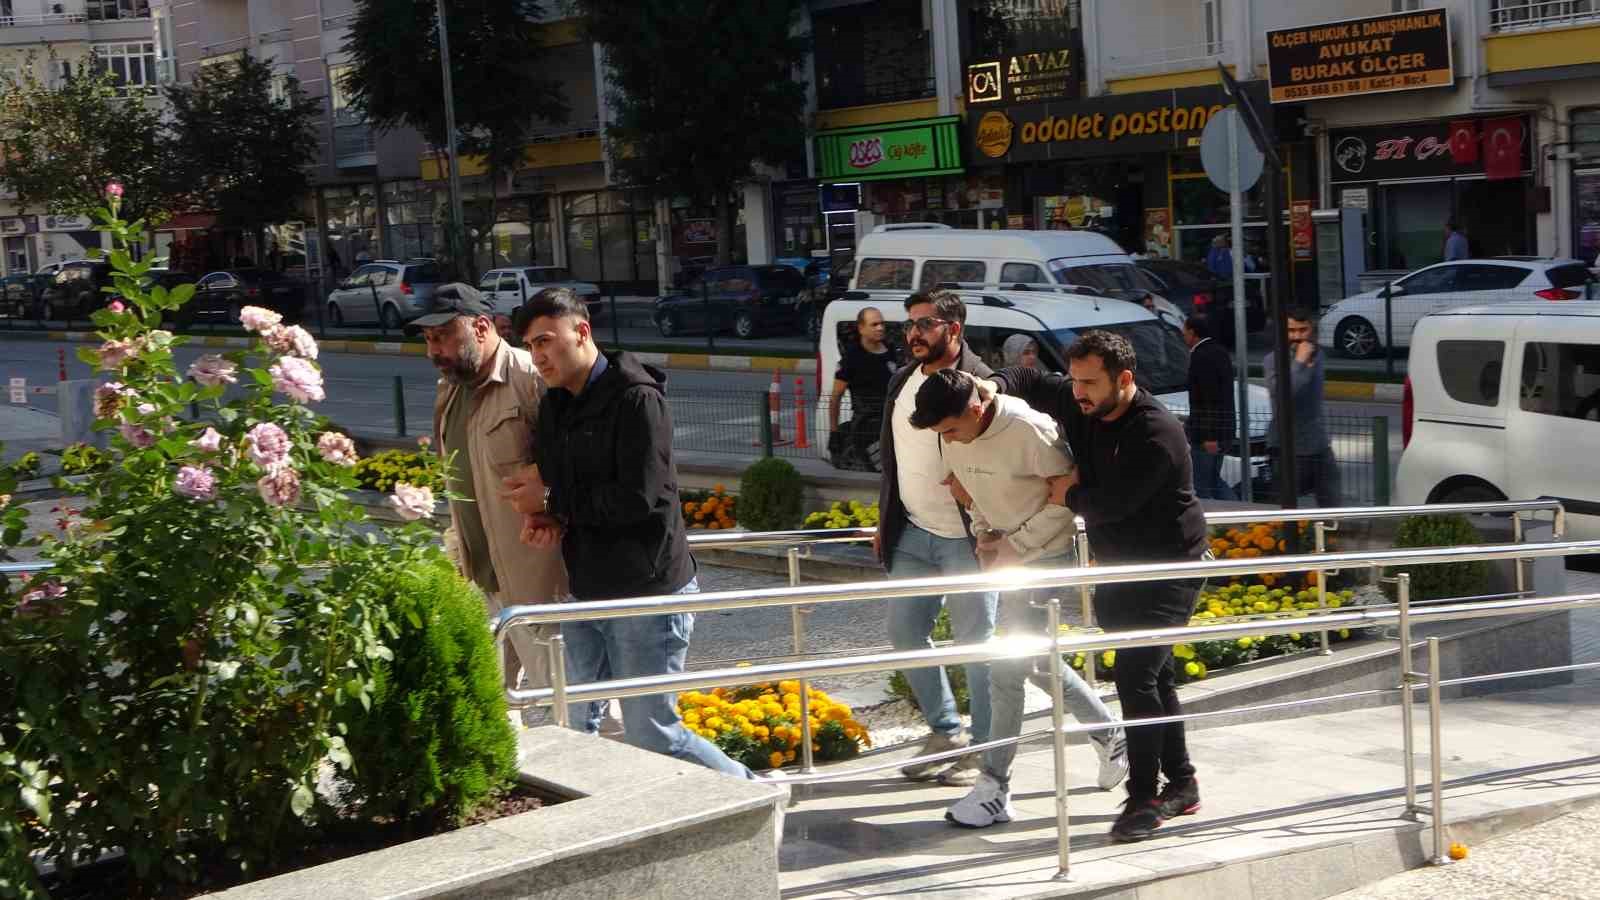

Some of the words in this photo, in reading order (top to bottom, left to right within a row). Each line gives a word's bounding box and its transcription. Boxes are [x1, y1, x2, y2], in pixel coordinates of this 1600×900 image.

[1319, 37, 1393, 60] AVUKAT
[1008, 50, 1070, 76] AYVAZ
[1291, 61, 1355, 81] BURAK
[1360, 53, 1425, 75] ÖLÇER
[1020, 113, 1104, 143] adalet
